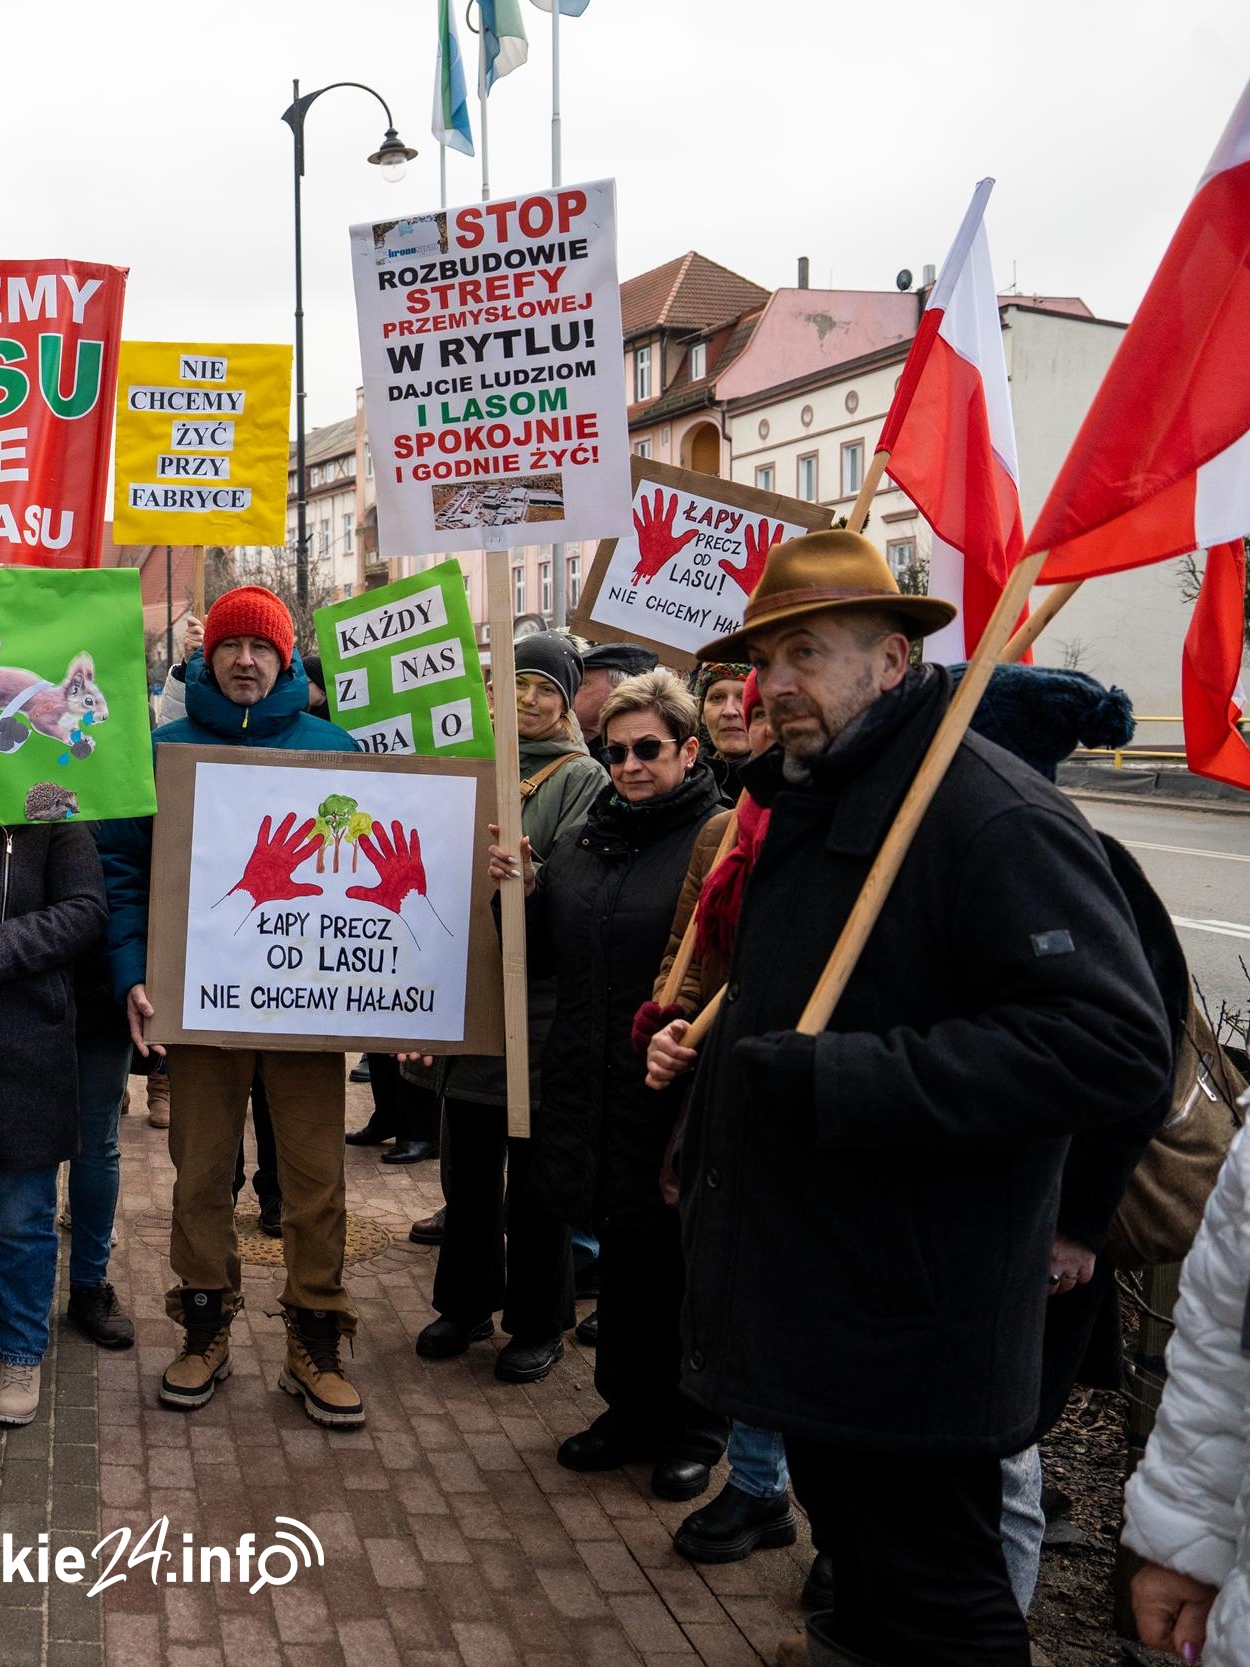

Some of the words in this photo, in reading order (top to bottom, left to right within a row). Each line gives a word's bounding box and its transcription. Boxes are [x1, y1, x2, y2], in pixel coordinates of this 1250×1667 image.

[455, 189, 588, 249] STOP
[378, 238, 589, 291] ROZBUDOWIE
[406, 266, 567, 315] STREFY
[383, 292, 593, 339] PRZEMYSŁOWEJ
[386, 342, 424, 374] W
[439, 319, 595, 368] RYTLU!
[182, 360, 224, 380] NIE
[388, 375, 473, 401] DAJCIE
[480, 360, 596, 390] LUDZIOM
[130, 391, 243, 411] CHCEMY
[417, 404, 427, 427] I
[441, 387, 568, 425] LASOM
[176, 422, 227, 446] ŻYĆ
[394, 413, 599, 460] SPOKOJNIE
[160, 456, 225, 476] PRZY
[396, 467, 403, 483] I
[412, 454, 520, 482] GODNIE
[530, 443, 599, 470] ŻYĆ!
[132, 489, 245, 508] FABRYCE
[683, 501, 743, 534] ŁAPY
[693, 554, 711, 566] OD
[695, 533, 743, 555] PRECZ
[670, 564, 727, 596] LASU!
[338, 599, 433, 652] KAŻDY
[608, 586, 638, 605] NIE
[646, 595, 713, 628] CHCEMY
[713, 615, 742, 634] HAŁ
[339, 678, 357, 703] Z
[399, 647, 455, 683] NAS
[441, 713, 462, 737] O
[257, 912, 311, 937] ŁAPY
[320, 914, 393, 940] PRECZ
[267, 944, 304, 970] OD
[318, 946, 399, 974] LASU!
[200, 984, 241, 1010] NIE
[250, 986, 338, 1011] CHCEMY
[346, 985, 435, 1013] HAŁASU
